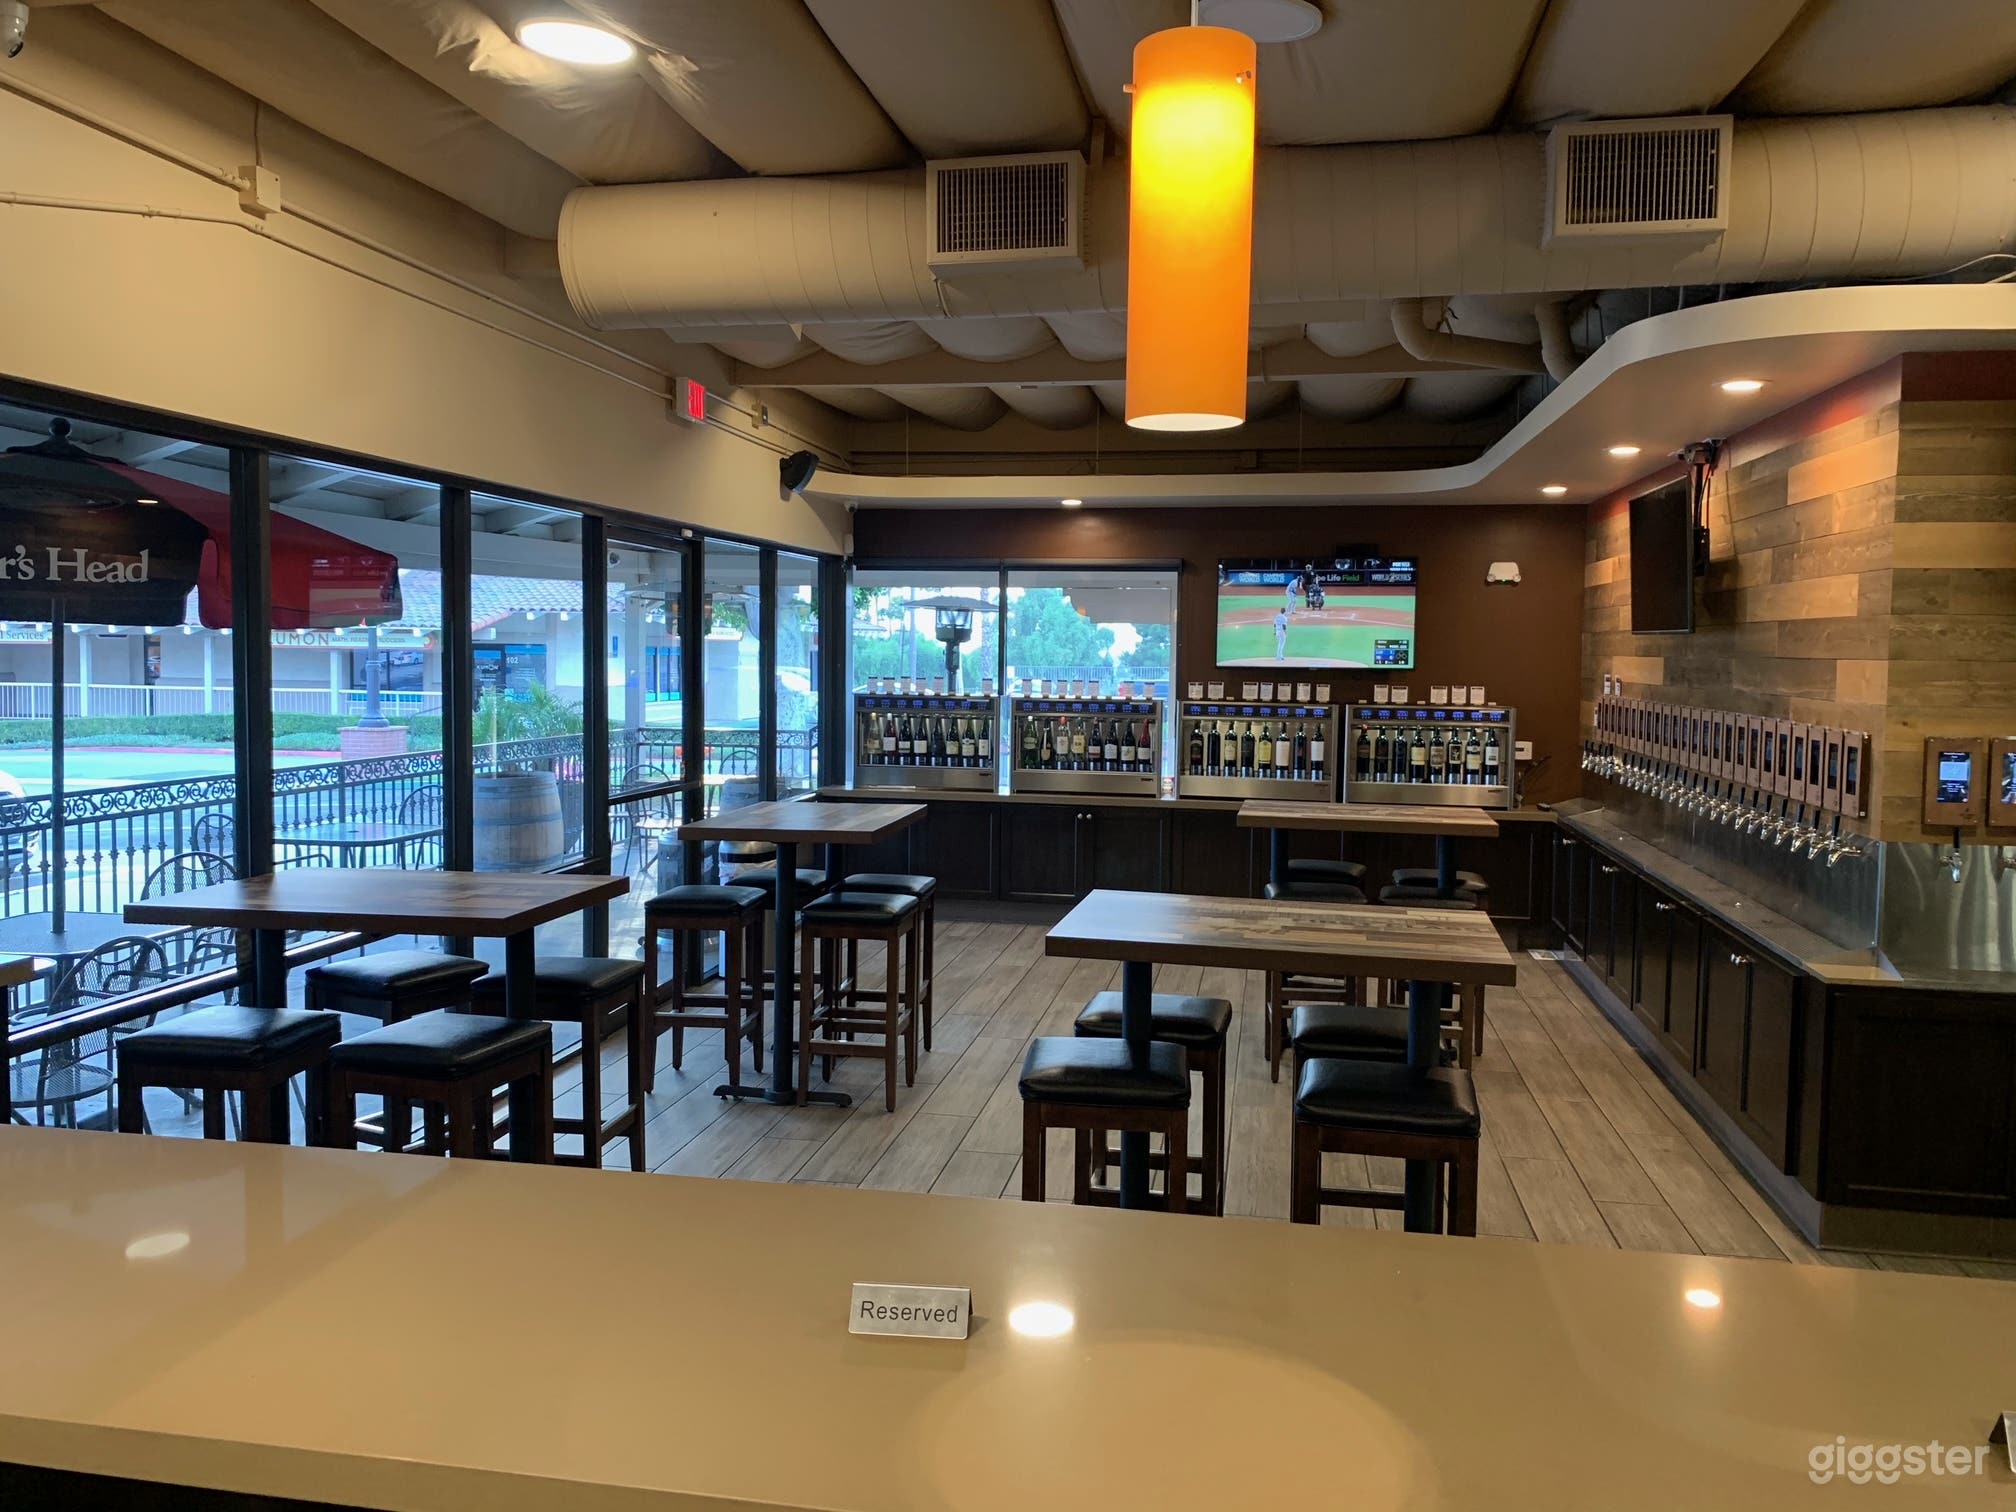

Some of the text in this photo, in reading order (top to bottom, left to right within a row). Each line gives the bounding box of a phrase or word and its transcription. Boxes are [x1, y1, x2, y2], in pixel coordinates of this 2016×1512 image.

[46, 547, 149, 583] Head
[1342, 574, 1360, 582] Field
[6, 630, 45, 640] Services
[274, 632, 329, 646] UMON
[506, 656, 519, 664] 102
[860, 1300, 958, 1323] Reserved
